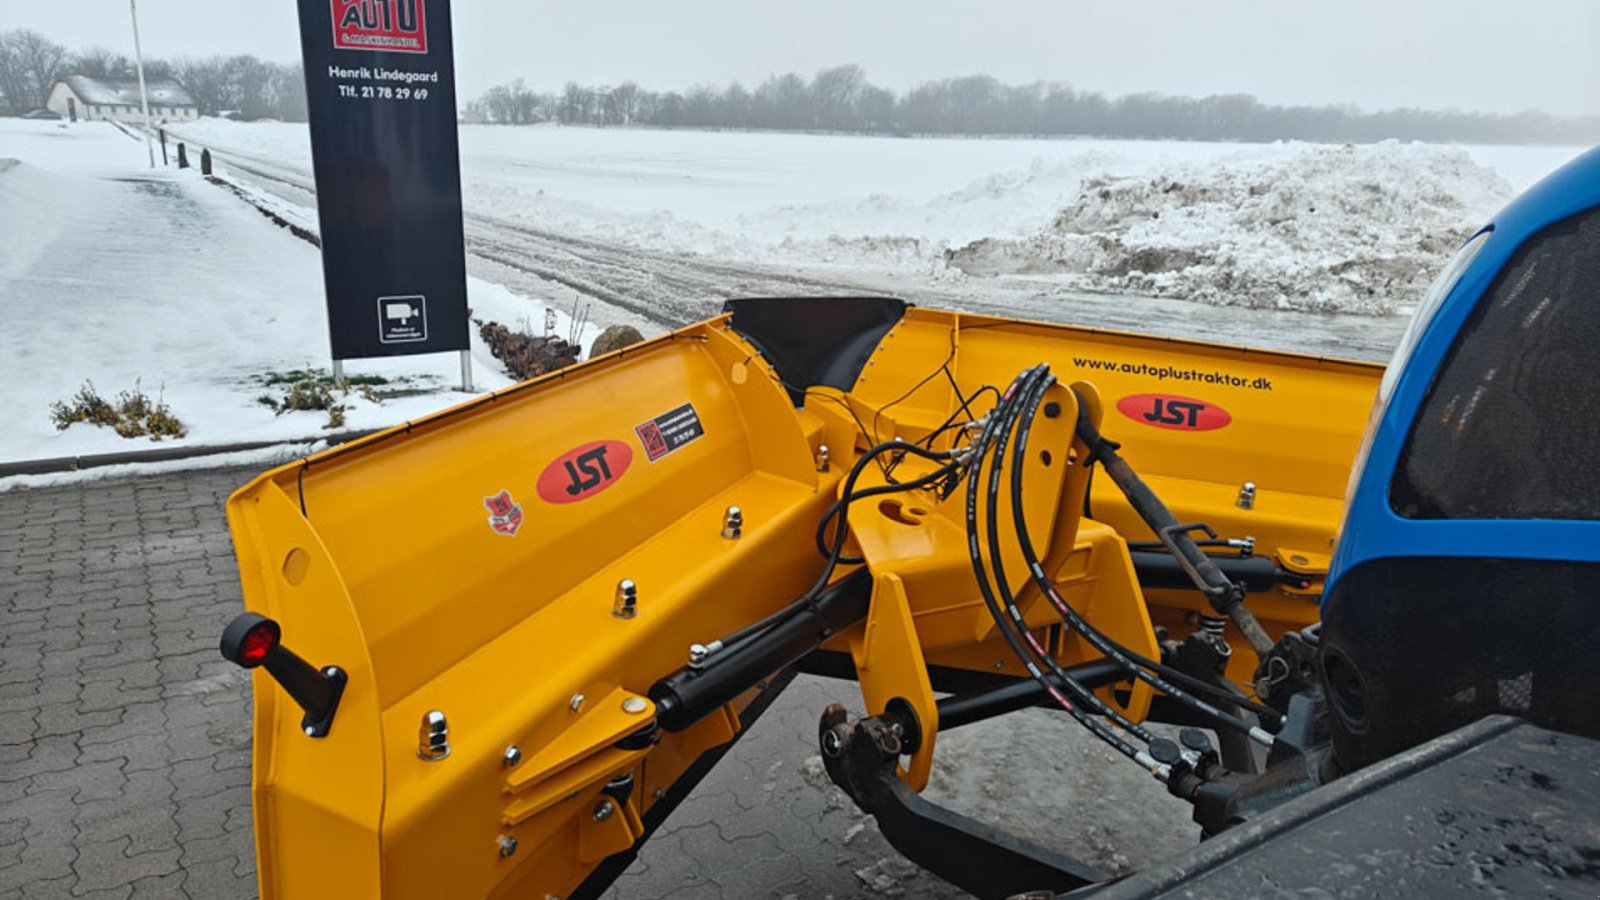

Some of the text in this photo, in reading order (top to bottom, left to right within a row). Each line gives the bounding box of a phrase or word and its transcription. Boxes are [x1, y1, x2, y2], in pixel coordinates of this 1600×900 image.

[340, 0, 418, 32] AUTO
[328, 66, 438, 83] Henrik Lindegaard
[338, 85, 429, 100] Tlf. 21 78 29 69
[1073, 356, 1273, 391] www.autoplustraktor.dk
[1143, 398, 1205, 427] JST
[564, 445, 612, 496] JST
